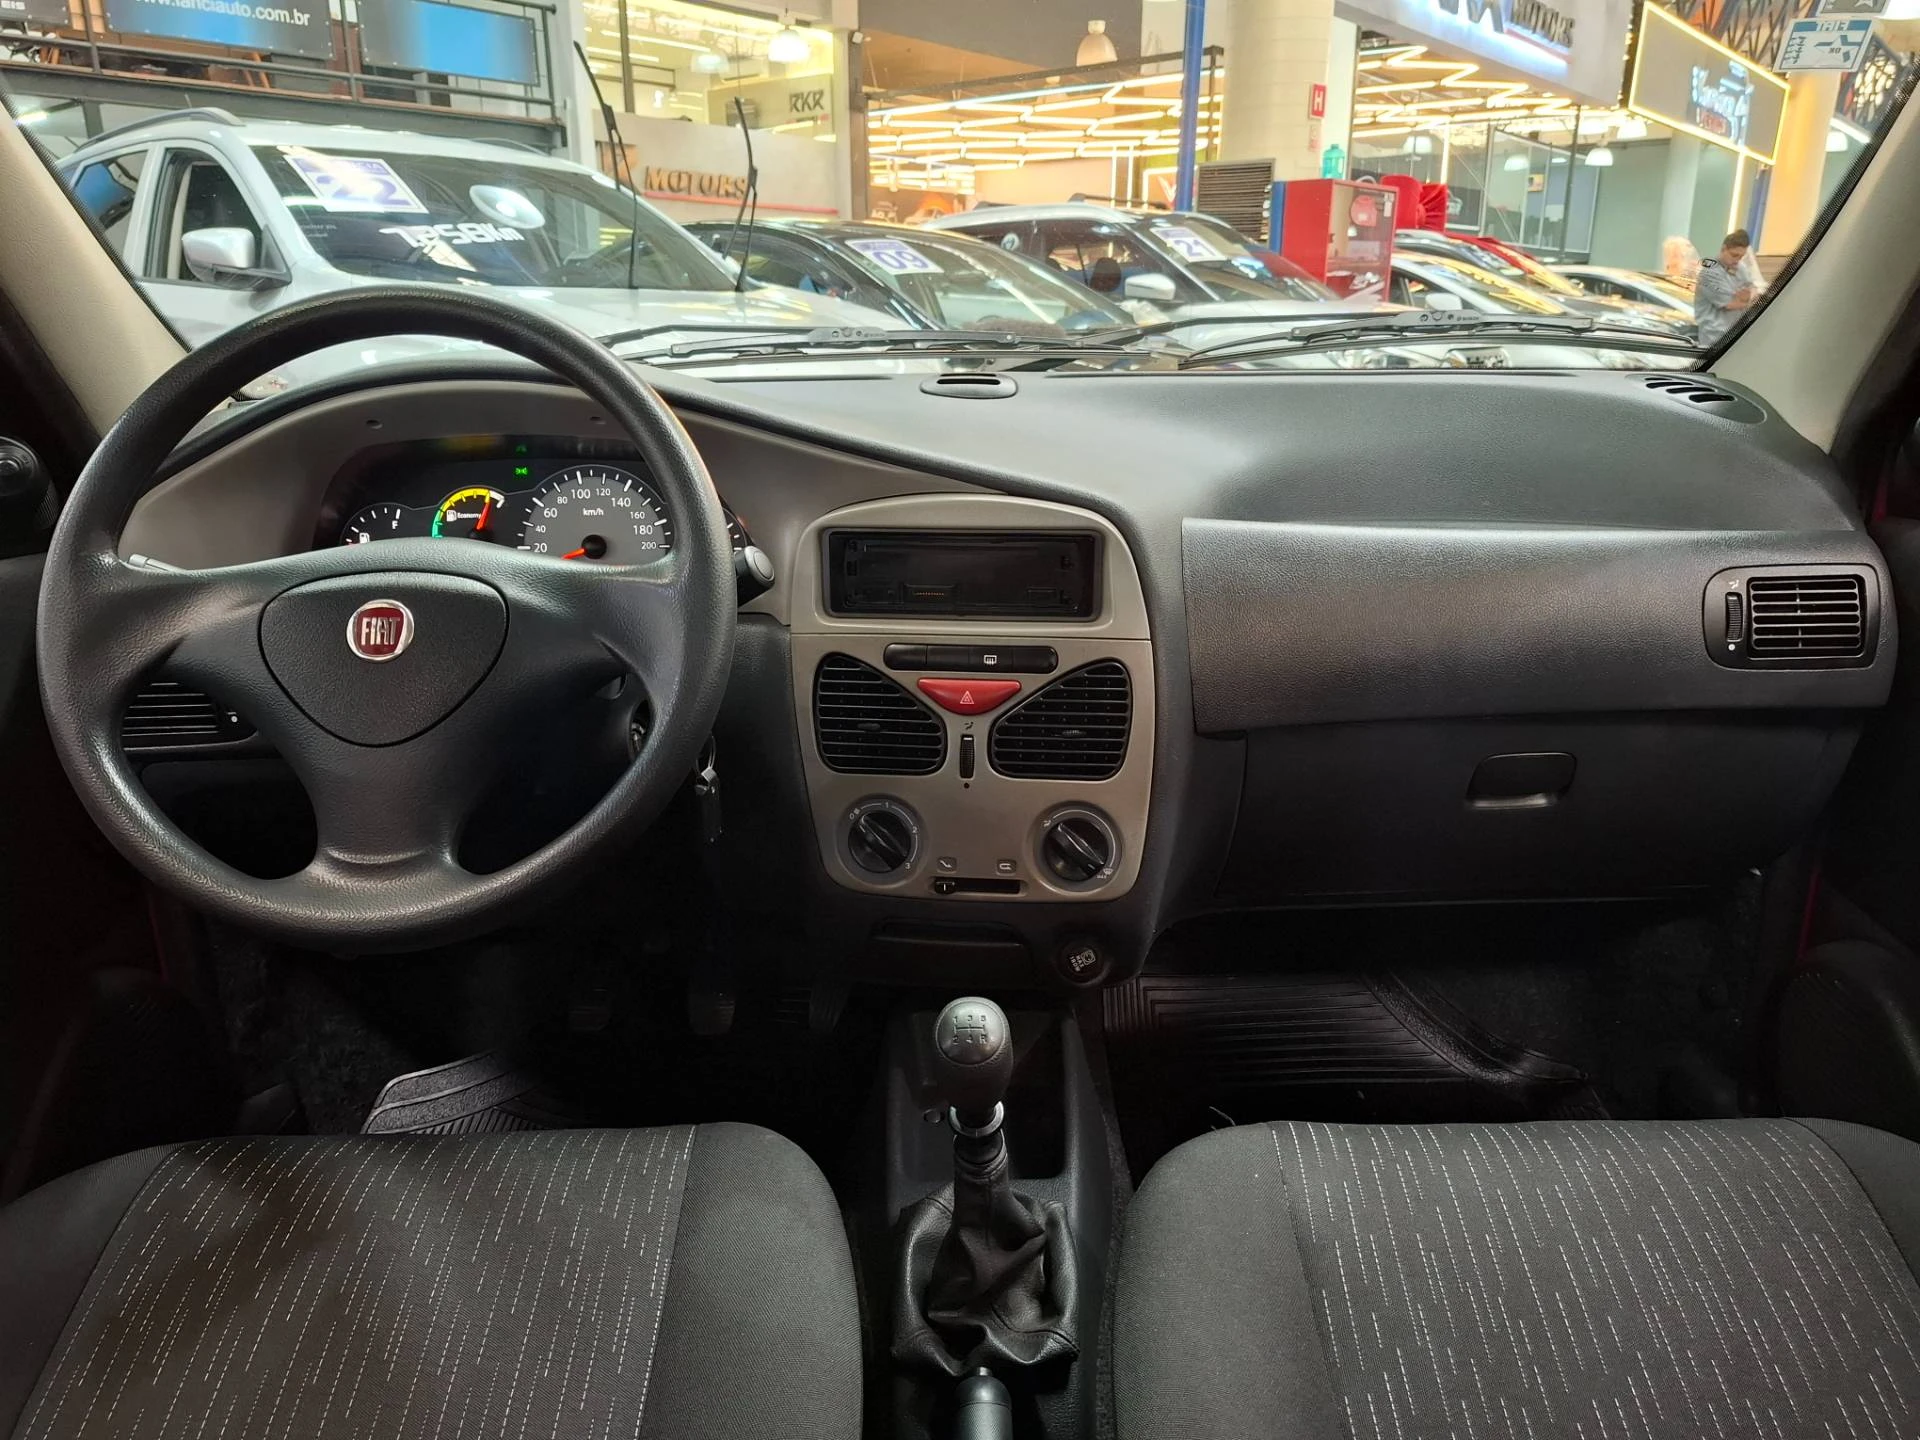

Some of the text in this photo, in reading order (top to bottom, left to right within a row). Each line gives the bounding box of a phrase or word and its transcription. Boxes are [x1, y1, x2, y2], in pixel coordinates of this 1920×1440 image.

[788, 90, 825, 113] RKR
[1313, 89, 1324, 113] H
[644, 166, 747, 199] MOTORS
[872, 251, 929, 270] 09
[571, 488, 591, 499] 100
[595, 488, 611, 496] 120
[557, 496, 568, 504] 80
[611, 497, 631, 507] 140
[543, 507, 558, 518] 60
[583, 507, 604, 516] km/h
[630, 511, 645, 519] 160
[391, 520, 399, 530] F
[535, 525, 546, 533] 40
[633, 525, 653, 535] 180
[534, 543, 547, 553] 20
[641, 541, 657, 550] 200
[361, 616, 401, 646] FIAT
